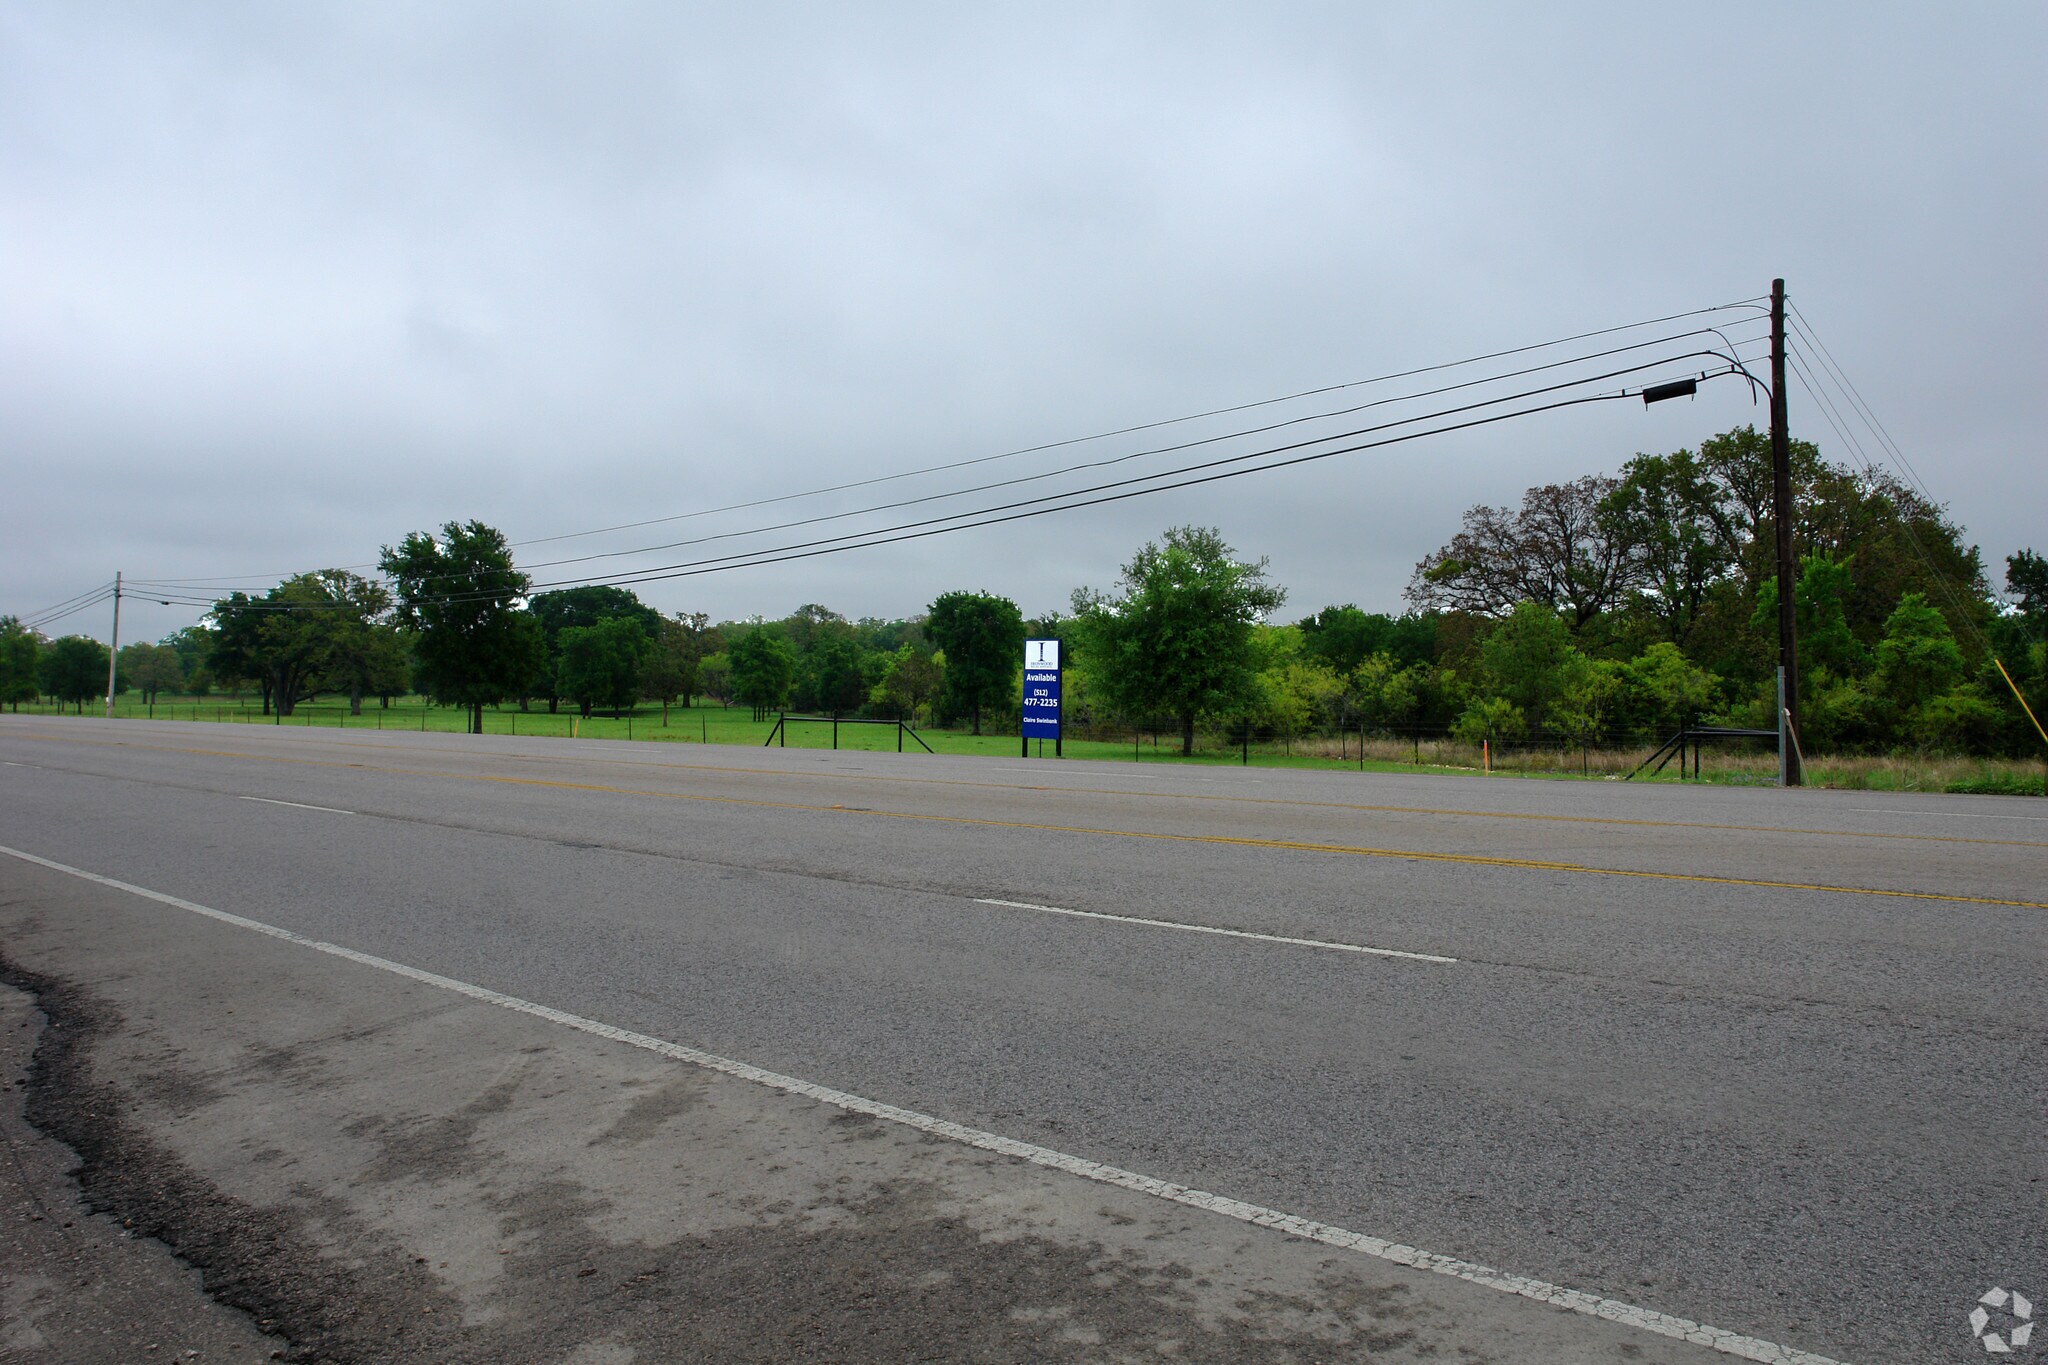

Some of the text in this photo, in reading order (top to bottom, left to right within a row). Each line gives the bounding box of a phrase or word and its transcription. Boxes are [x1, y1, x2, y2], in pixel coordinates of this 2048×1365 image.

[1026, 673, 1056, 682] Available
[1034, 688, 1048, 697] (512)
[1024, 698, 1058, 707] 477-2235
